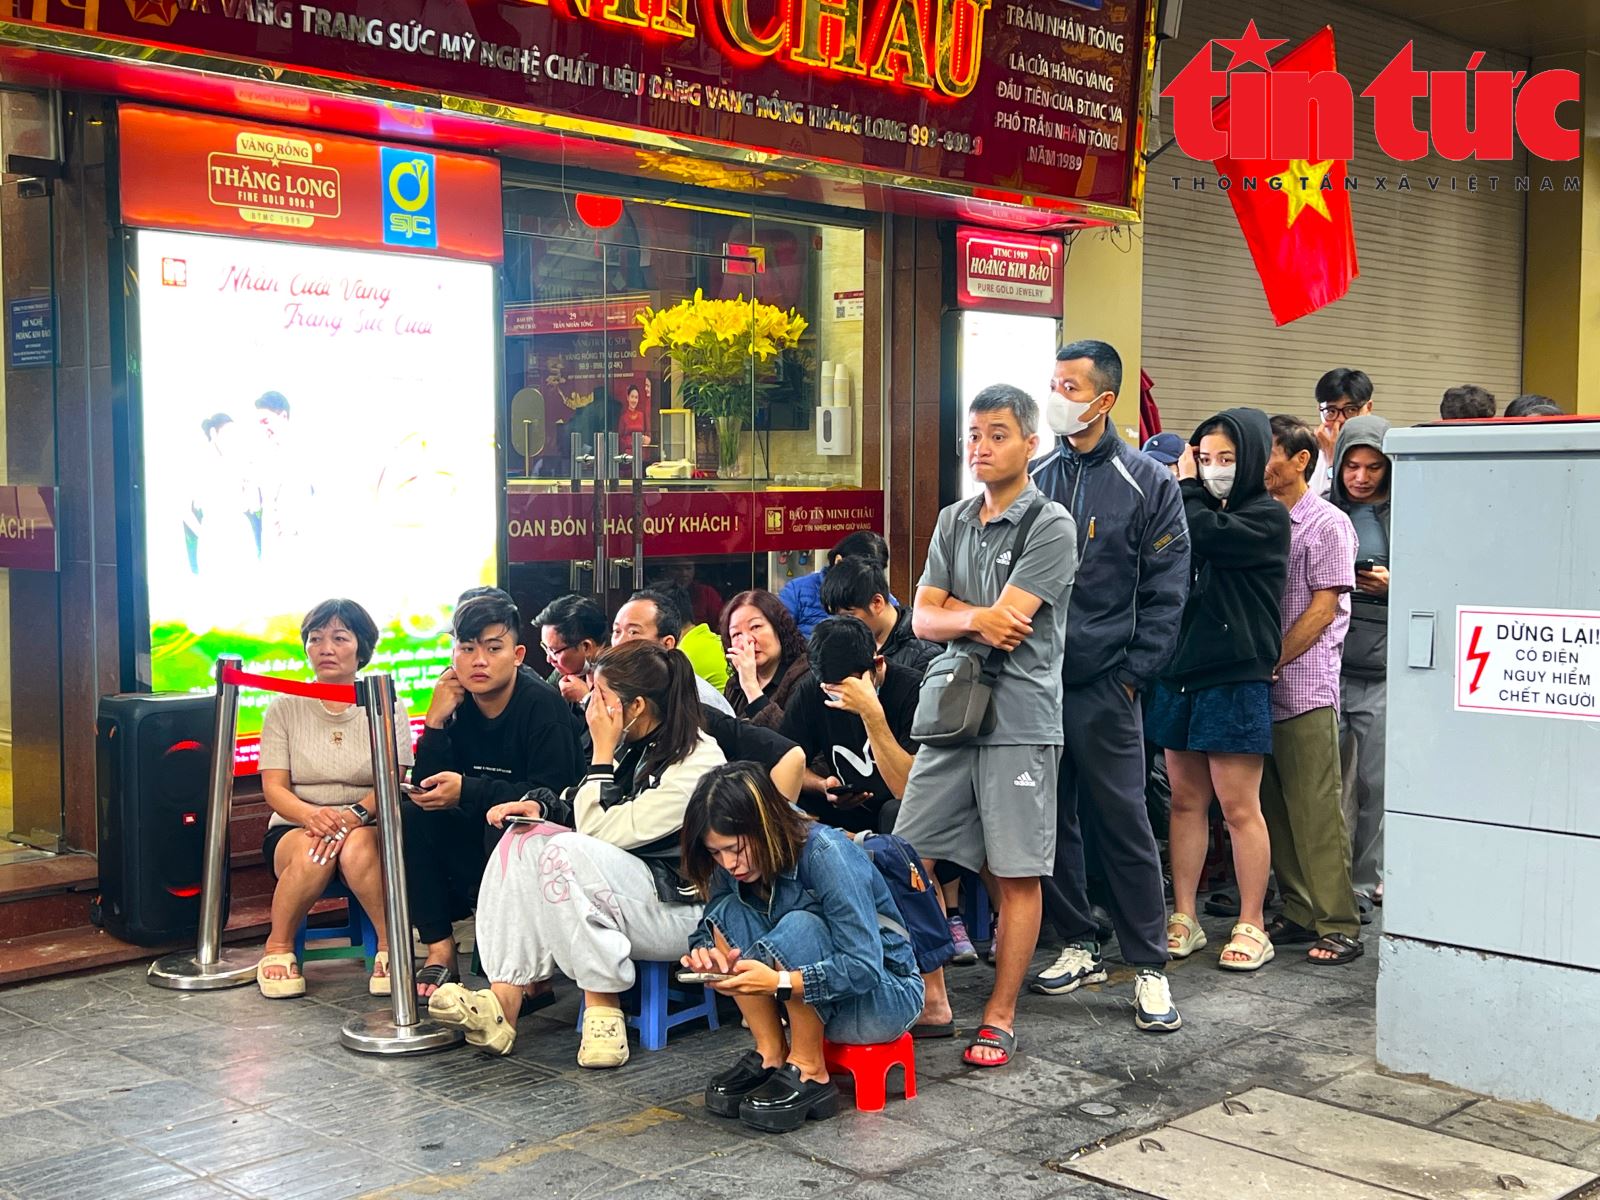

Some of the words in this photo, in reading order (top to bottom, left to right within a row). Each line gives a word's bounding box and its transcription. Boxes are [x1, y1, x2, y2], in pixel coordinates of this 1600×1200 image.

[1007, 4, 1044, 33] TRẦN
[1045, 15, 1085, 43] NHÂN
[1088, 26, 1124, 54] TÔNG
[301, 5, 383, 44] TRANG
[389, 20, 436, 56] SỨC
[439, 32, 476, 62] MỸ
[480, 42, 540, 82] NGHỆ
[544, 53, 599, 87] CHẤT
[603, 64, 645, 98] LIỆU
[705, 79, 753, 115] VÀNG
[756, 90, 804, 124] RỒNG
[807, 104, 862, 135] THĂNG
[864, 116, 907, 143] LONG
[1027, 54, 1049, 78] CỬA
[1051, 61, 1083, 86] HÀNG
[1086, 69, 1113, 93] VÀNG
[997, 77, 1021, 101] ĐẦU
[1025, 85, 1050, 107] TIÊN
[1077, 98, 1107, 120] BTMC
[995, 110, 1021, 131] PHỐ
[1023, 114, 1053, 139] TRẦN
[1055, 123, 1086, 145] NHÂN
[1088, 128, 1118, 151] TÔNG
[241, 138, 274, 153] VÀNG
[1057, 153, 1083, 171] 1989
[212, 163, 281, 191] THĂNG
[286, 175, 336, 199] LONG
[238, 191, 258, 203] FINE
[262, 194, 285, 206] GOLD
[252, 212, 275, 222] BTMC
[993, 247, 1013, 258] BTMC
[1014, 250, 1028, 260] 1989
[1007, 262, 1027, 279] KIM
[978, 283, 994, 293] PURE
[996, 284, 1014, 295] GOLD
[1016, 287, 1044, 297] JEWELRY
[621, 350, 637, 358] LONG
[826, 508, 850, 520] MINH
[851, 506, 875, 519] CHÂU
[508, 519, 546, 537] OAN
[551, 515, 587, 537] ĐÓN
[643, 513, 675, 535] QUÝ
[679, 512, 730, 533] KHÁCH
[735, 515, 739, 532] !
[1497, 620, 1554, 643] DỪNG
[1562, 627, 1600, 648] LẠI!
[1516, 647, 1538, 661] CÓ
[1542, 648, 1579, 665] ĐIỆN
[1503, 669, 1547, 683] NGUY
[1552, 667, 1590, 686] HIỂM
[1499, 686, 1540, 703] CHẾT
[1545, 692, 1595, 708] NGƯỜI
